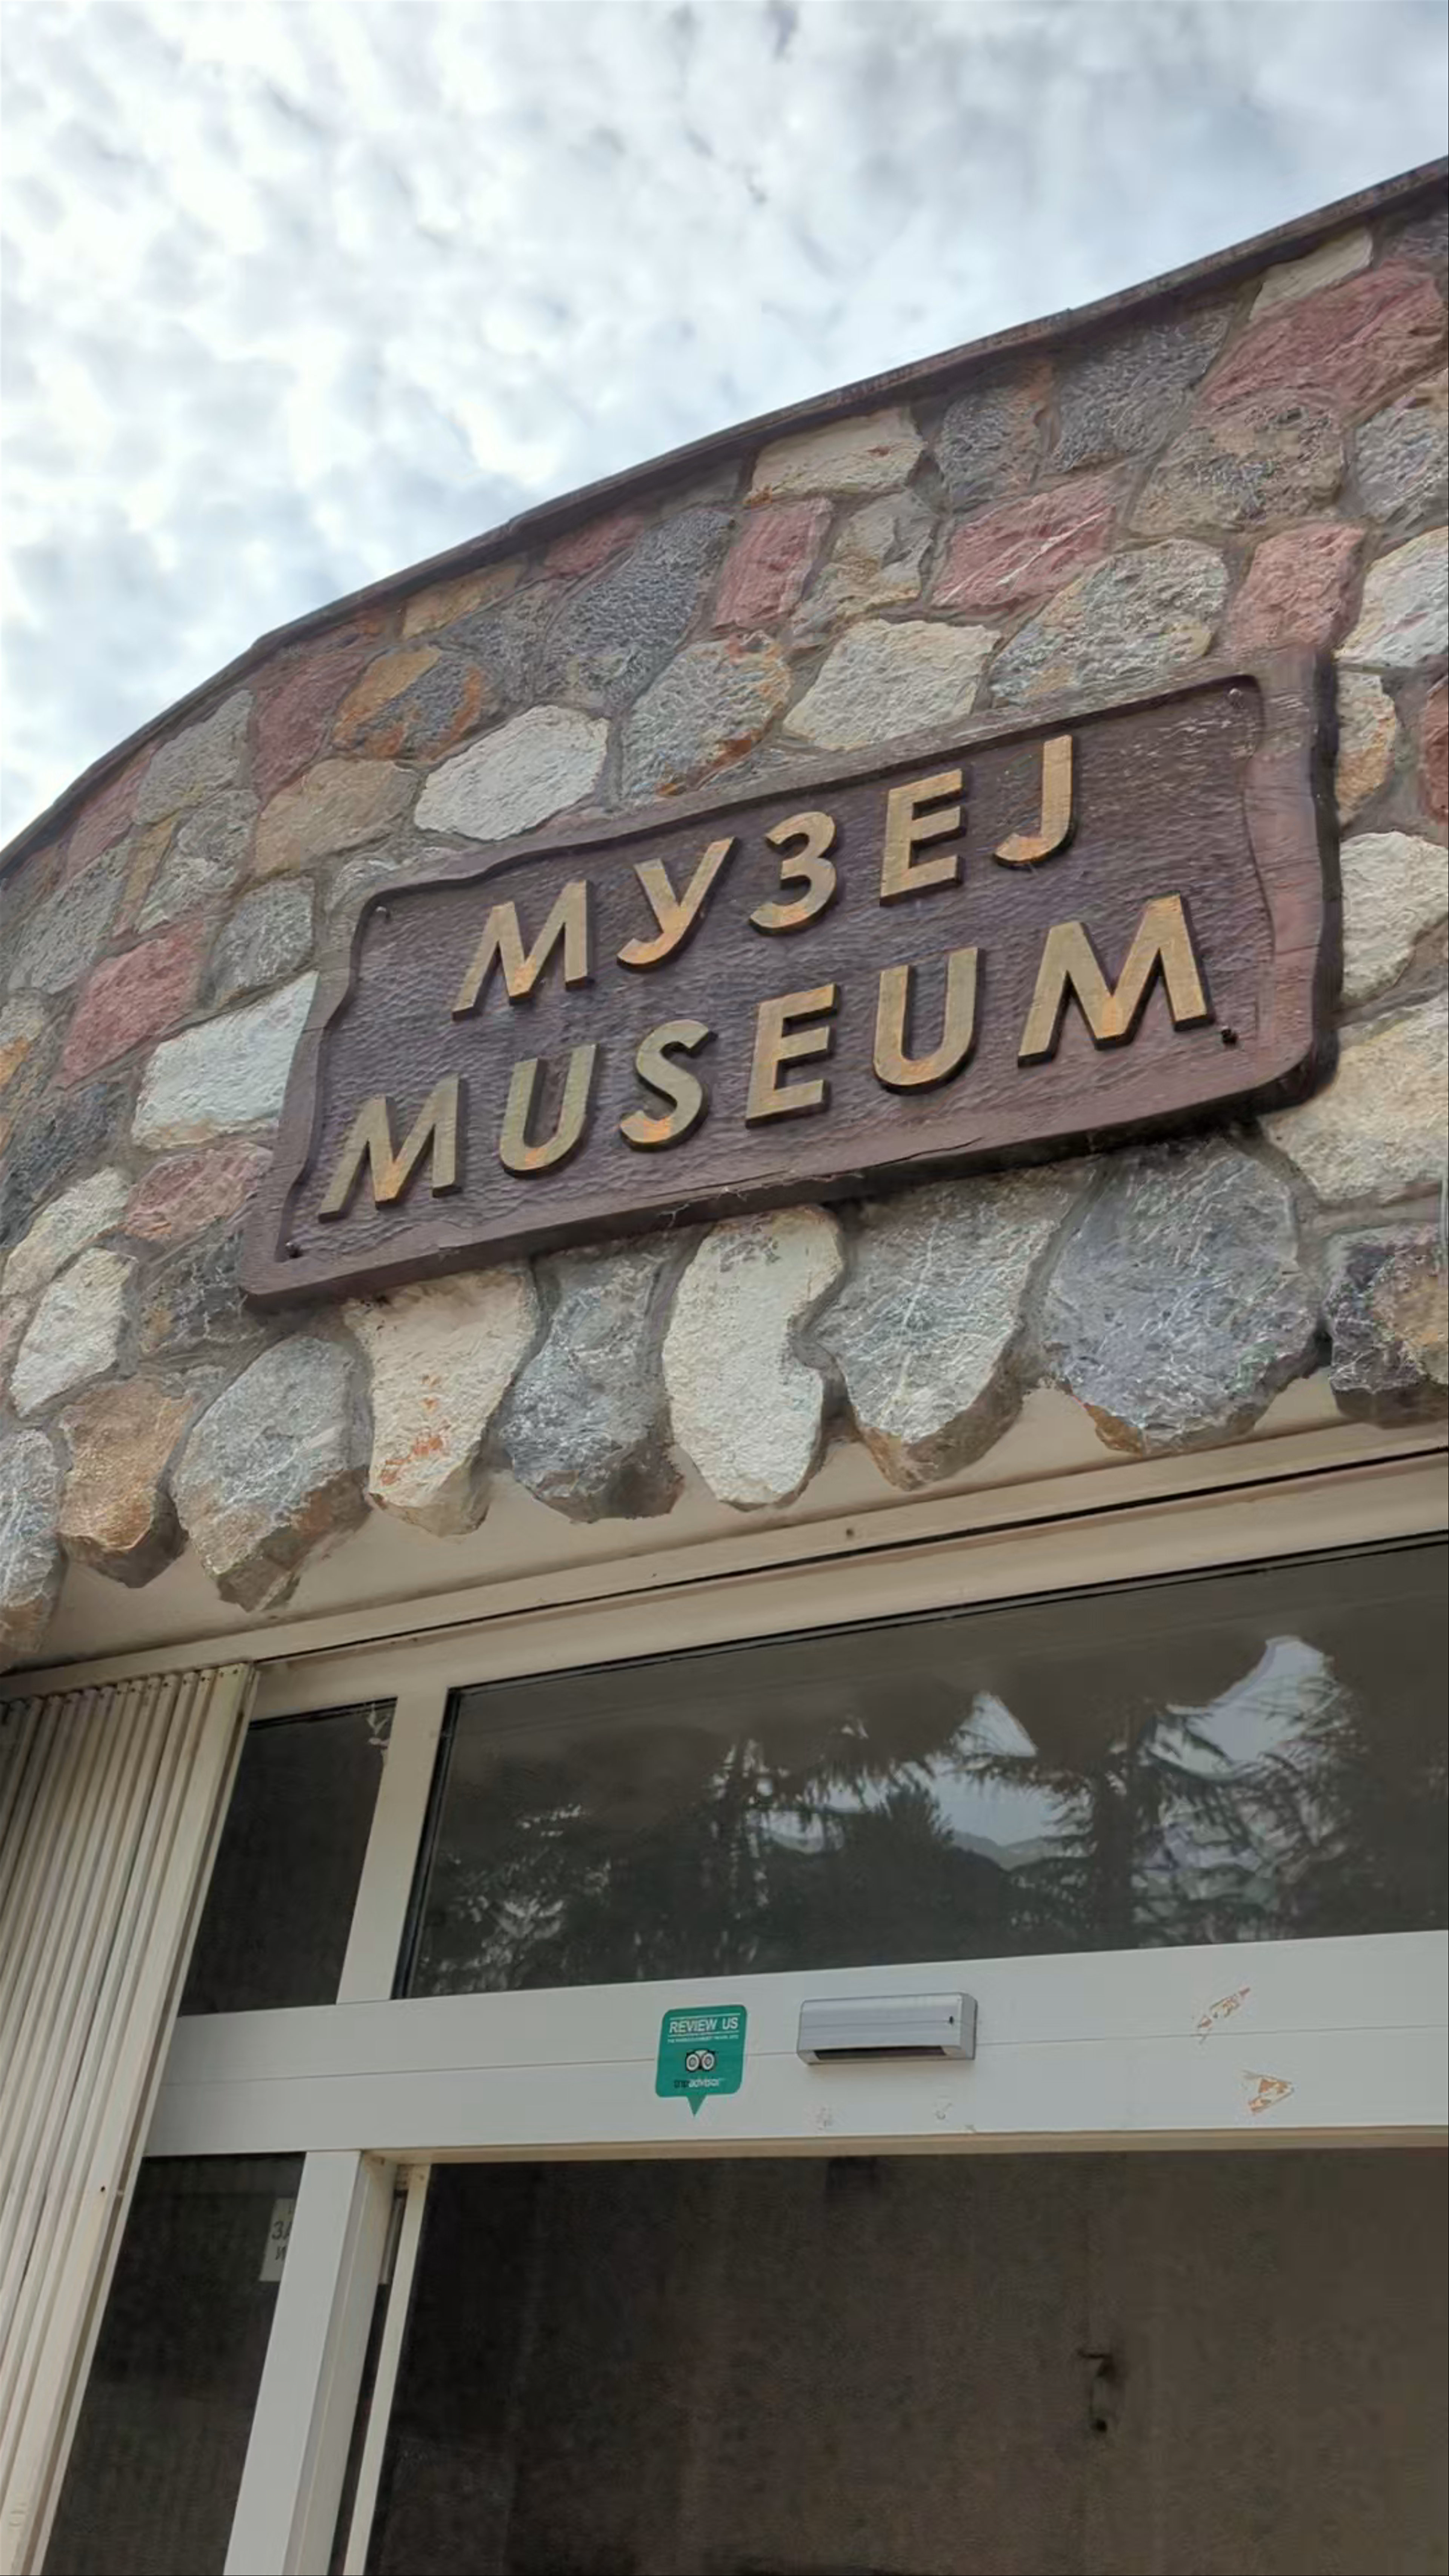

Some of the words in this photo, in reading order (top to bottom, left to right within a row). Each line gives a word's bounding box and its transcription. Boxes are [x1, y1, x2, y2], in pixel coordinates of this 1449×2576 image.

[453, 734, 1076, 1020] МУЗЕЈ
[318, 894, 1212, 1221] MUSEUM
[669, 2019, 717, 2033] REVIEW
[722, 2017, 738, 2030] US
